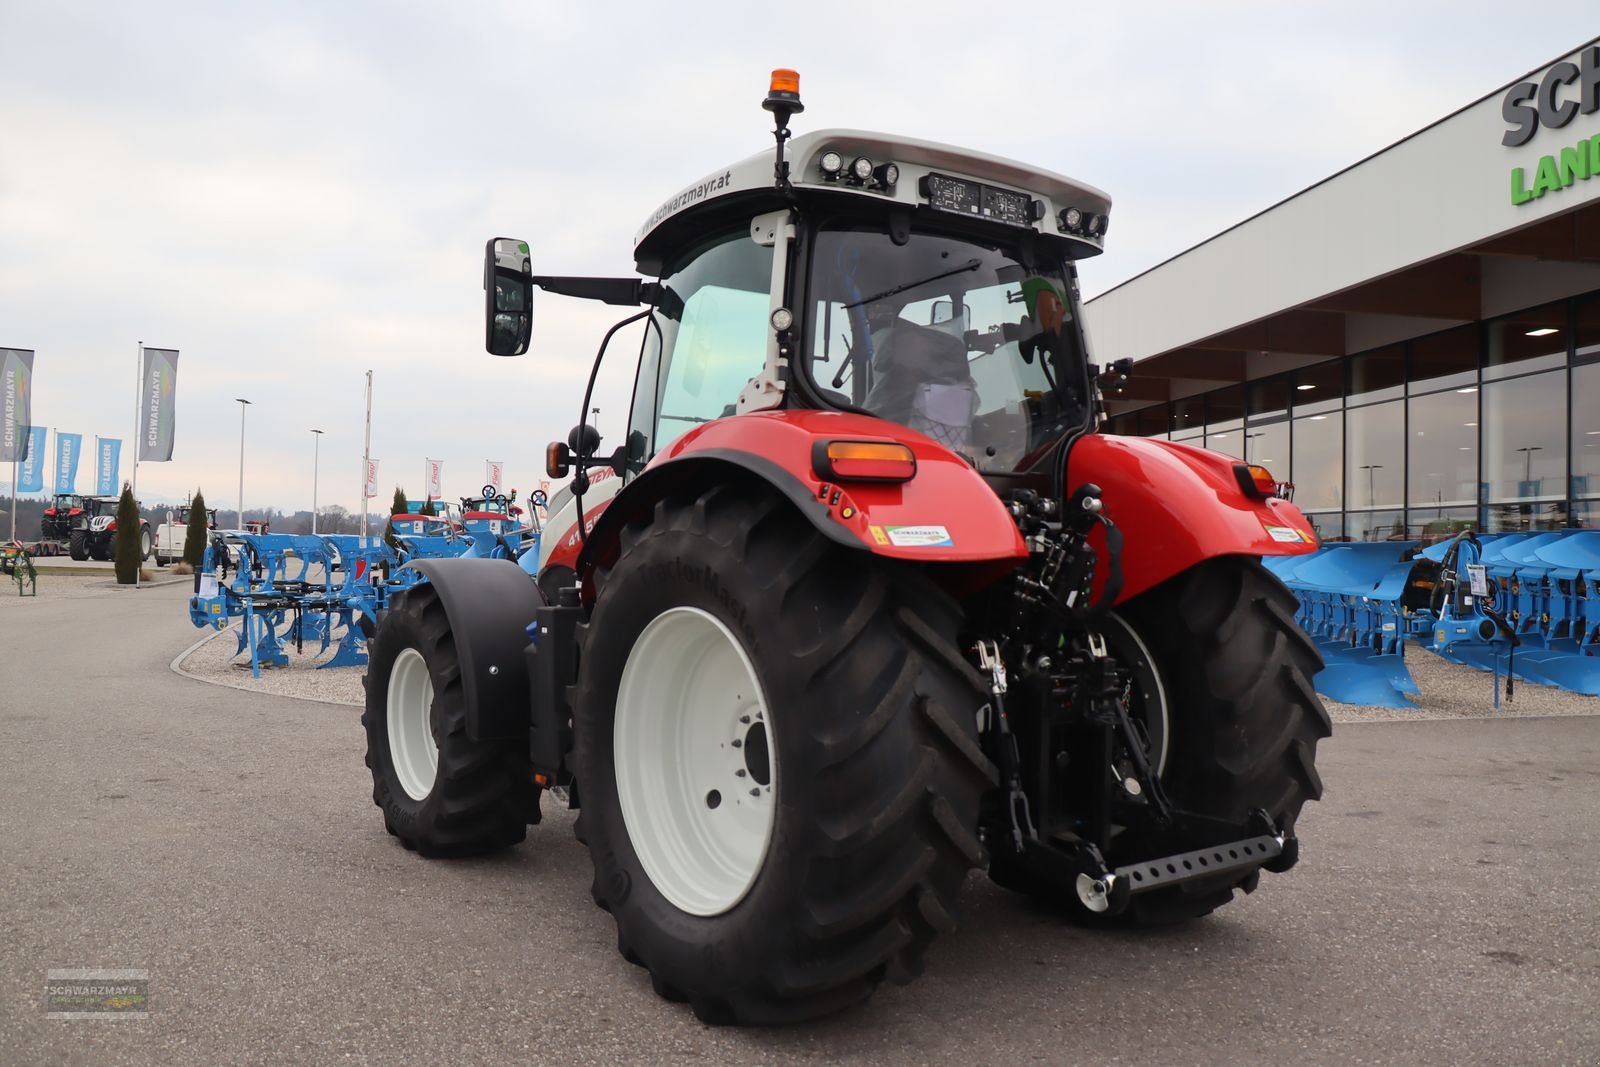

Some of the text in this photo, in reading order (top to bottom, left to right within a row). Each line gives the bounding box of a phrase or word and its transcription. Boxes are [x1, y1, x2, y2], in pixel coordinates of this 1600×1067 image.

[4, 370, 16, 448] SCHWARZMAYR
[148, 370, 161, 447] SCHWARZMAYR
[568, 519, 594, 547] 415
